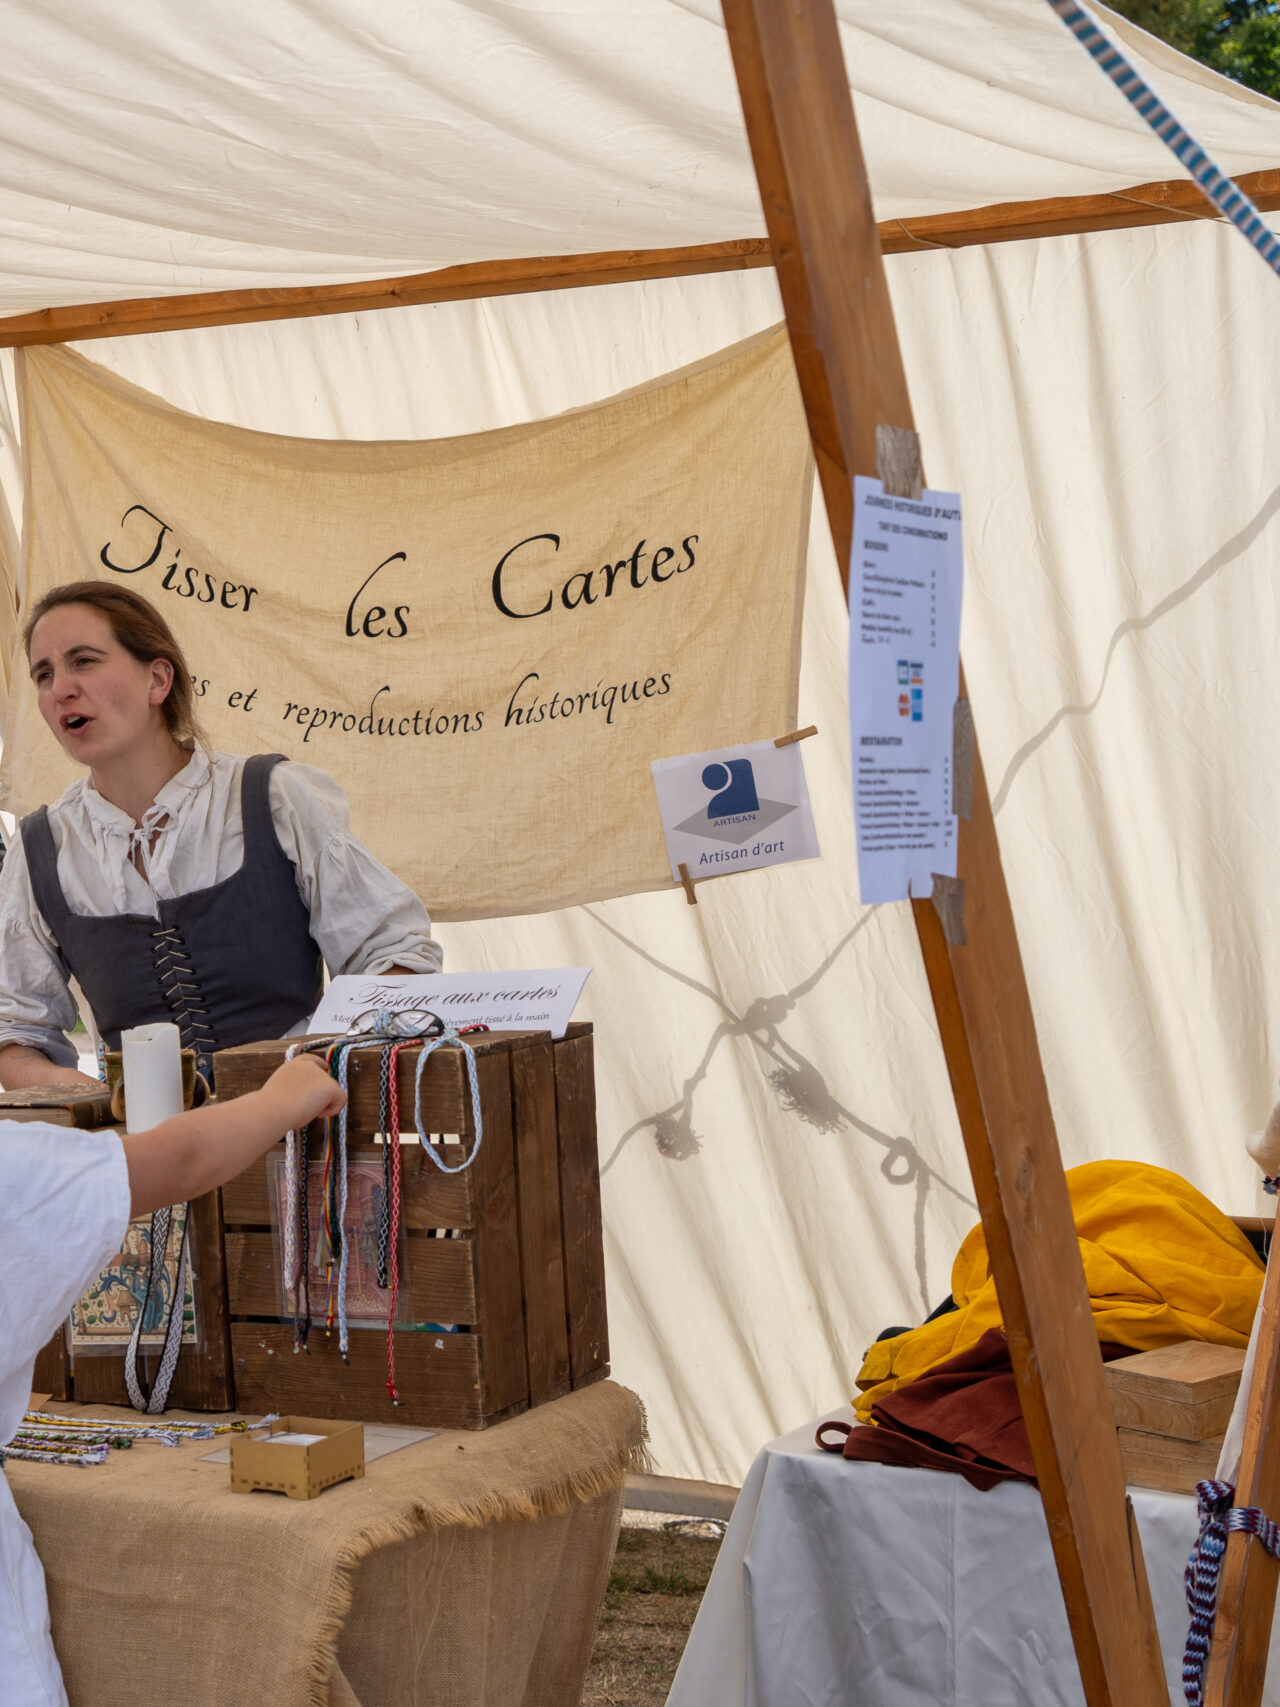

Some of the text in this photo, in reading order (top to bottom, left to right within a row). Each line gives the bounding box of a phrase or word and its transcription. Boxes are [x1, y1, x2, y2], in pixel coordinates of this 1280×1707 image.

[99, 504, 700, 639] Tisser les Cartes
[227, 688, 258, 712] et
[282, 686, 485, 743] reproductions
[503, 672, 672, 729] historiques
[713, 813, 757, 828] ARTISAN
[699, 840, 785, 865] Artisan d'art
[349, 983, 561, 1010] Tissage aux cartes
